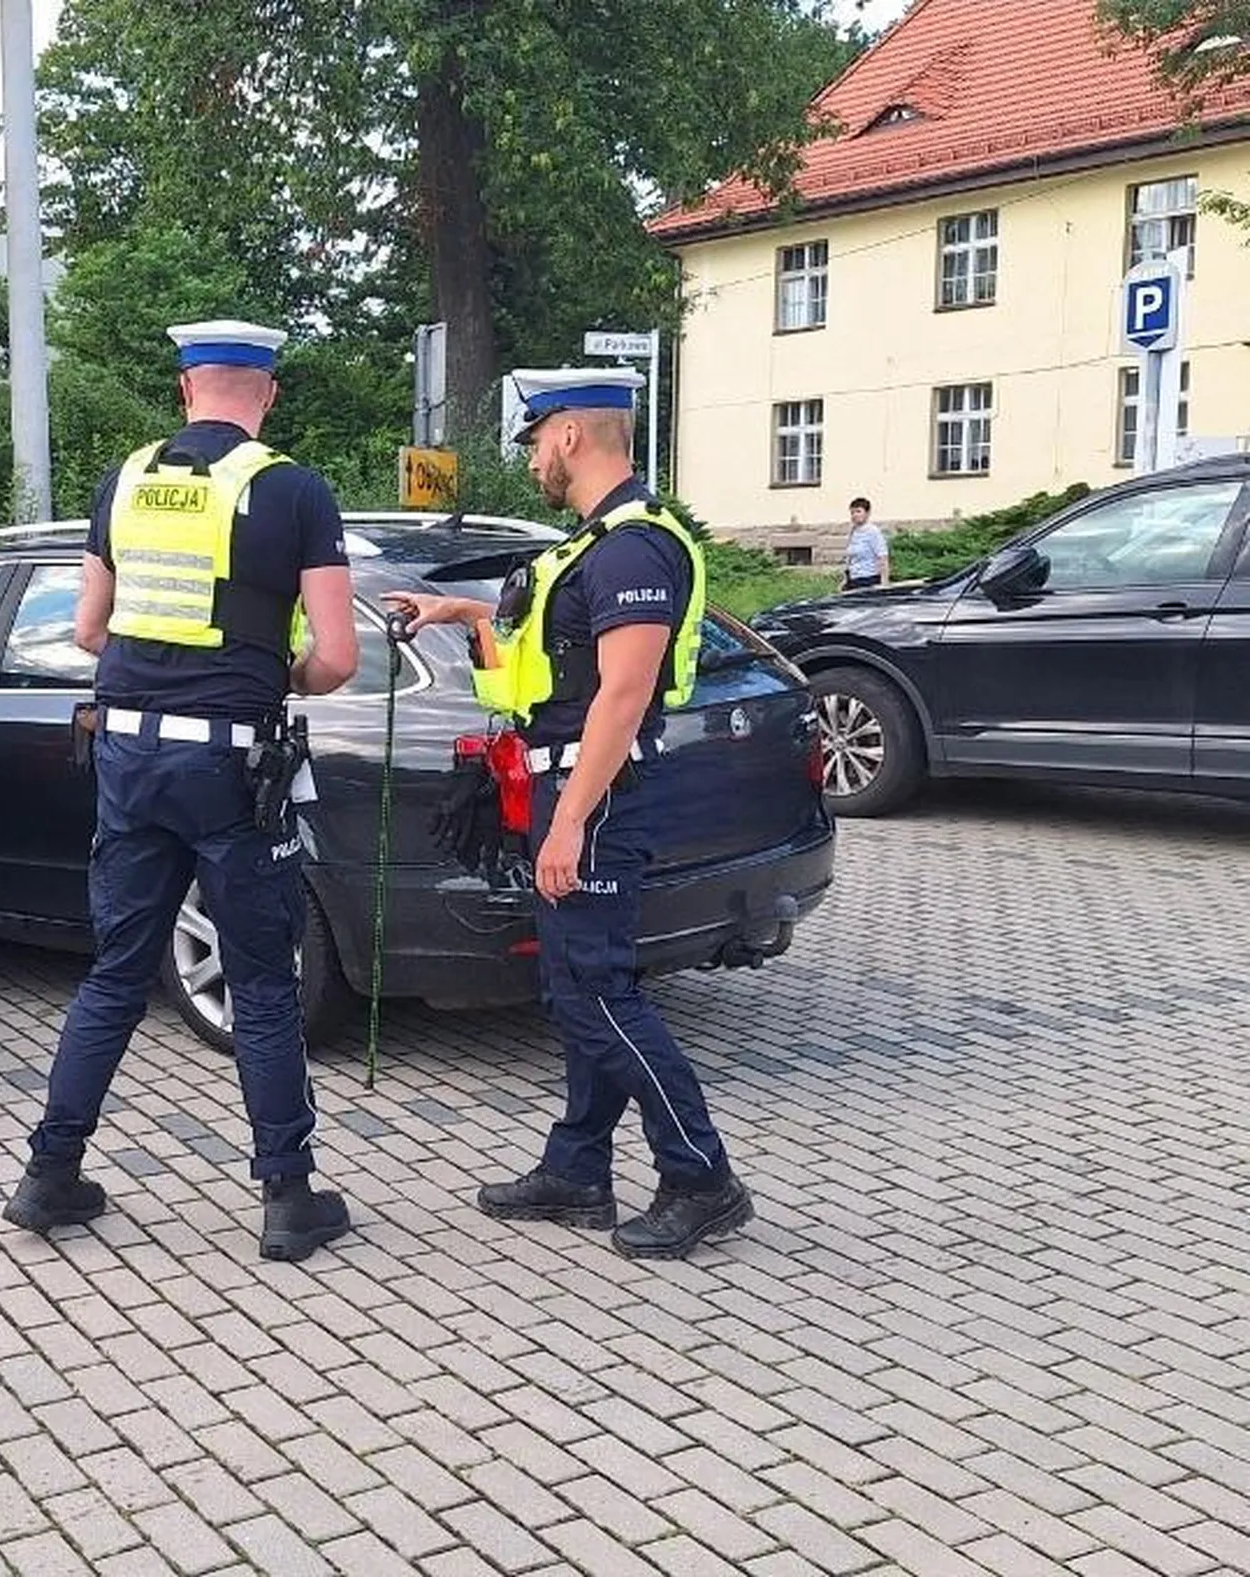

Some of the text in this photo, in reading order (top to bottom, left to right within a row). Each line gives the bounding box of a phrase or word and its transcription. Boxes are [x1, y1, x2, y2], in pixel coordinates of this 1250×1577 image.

[1135, 285, 1163, 330] P
[136, 488, 199, 508] POLICJA
[616, 588, 668, 605] POLICJA
